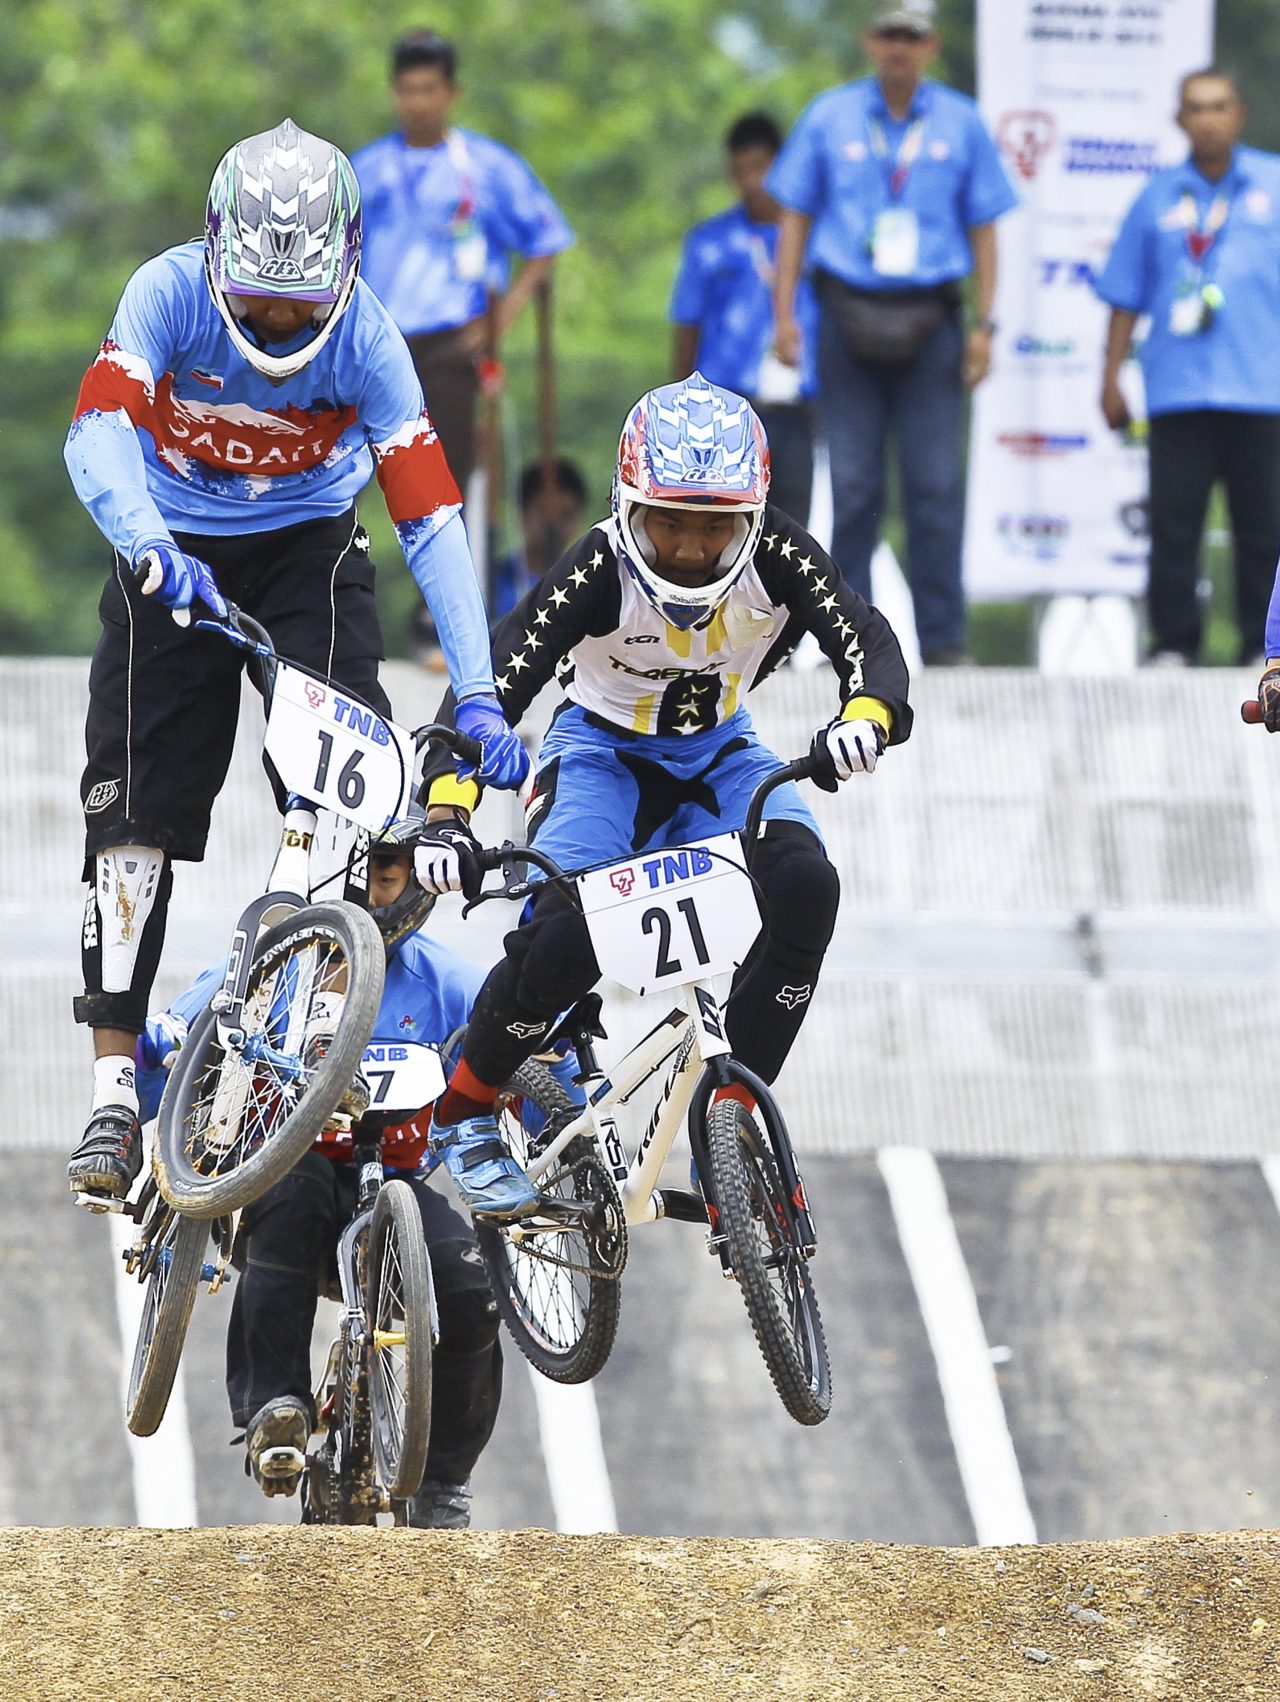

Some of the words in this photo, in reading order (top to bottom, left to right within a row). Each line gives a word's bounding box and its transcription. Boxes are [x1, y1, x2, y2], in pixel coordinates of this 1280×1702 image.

[334, 696, 391, 747] TNB
[314, 729, 366, 809] 16
[642, 846, 714, 889] TNB
[641, 896, 711, 978] 21
[362, 1047, 409, 1062] NB
